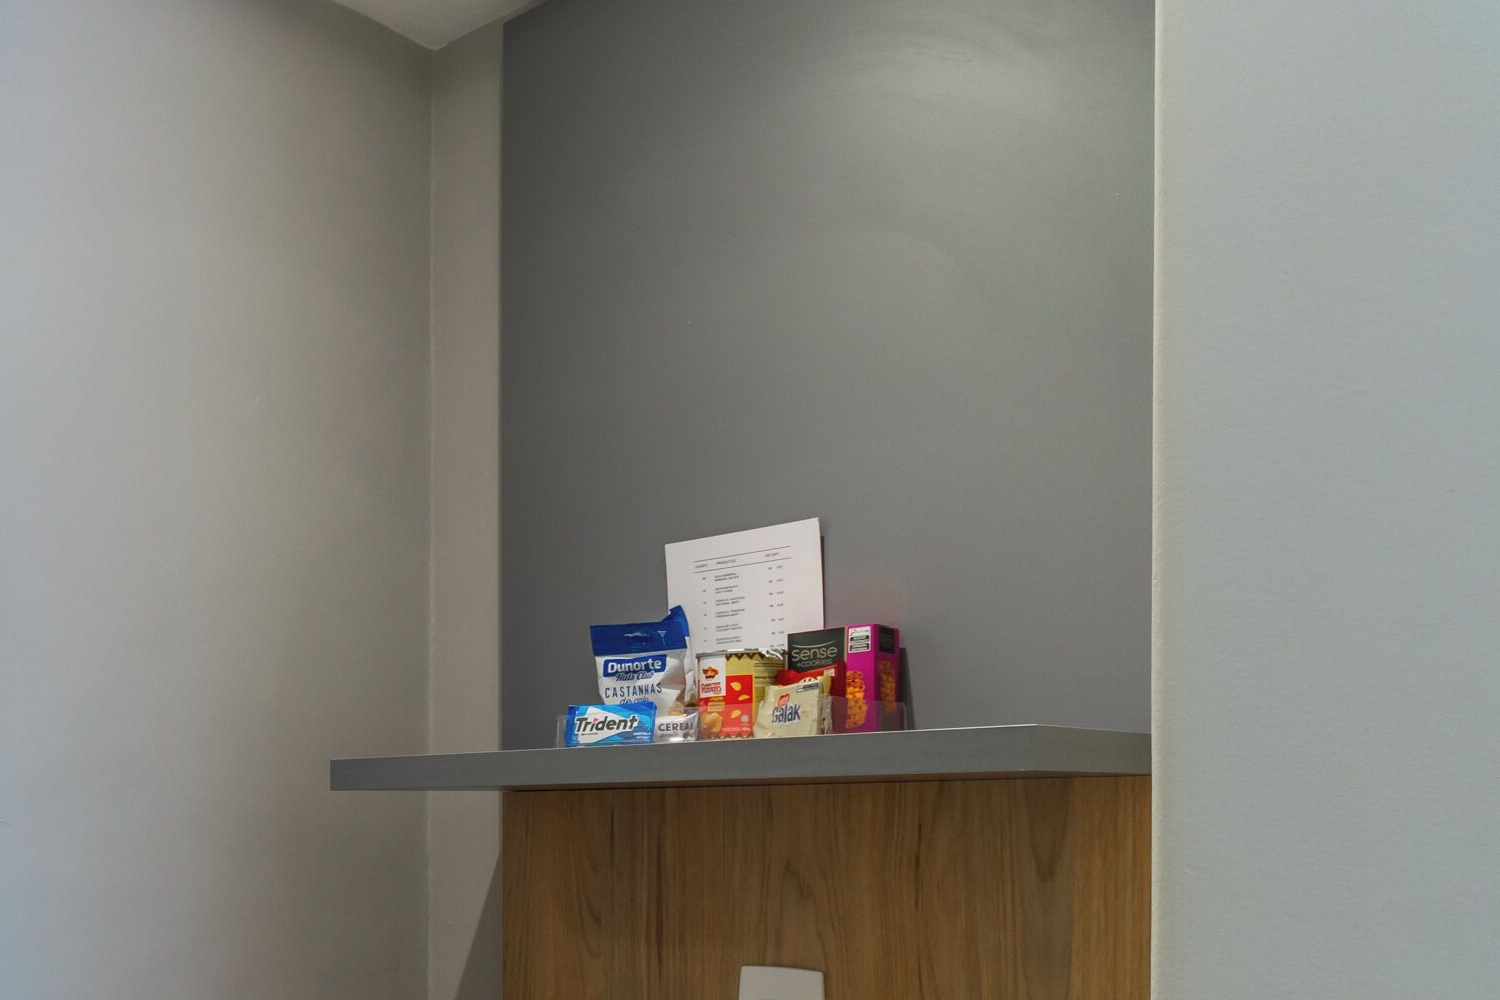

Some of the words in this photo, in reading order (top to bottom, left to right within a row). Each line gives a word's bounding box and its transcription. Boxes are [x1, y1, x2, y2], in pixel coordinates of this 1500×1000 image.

[791, 646, 838, 661] sense
[607, 658, 662, 673] Dunorte
[604, 682, 663, 699] CASTANHAS
[772, 703, 801, 724] Galak
[575, 715, 638, 732] Trident
